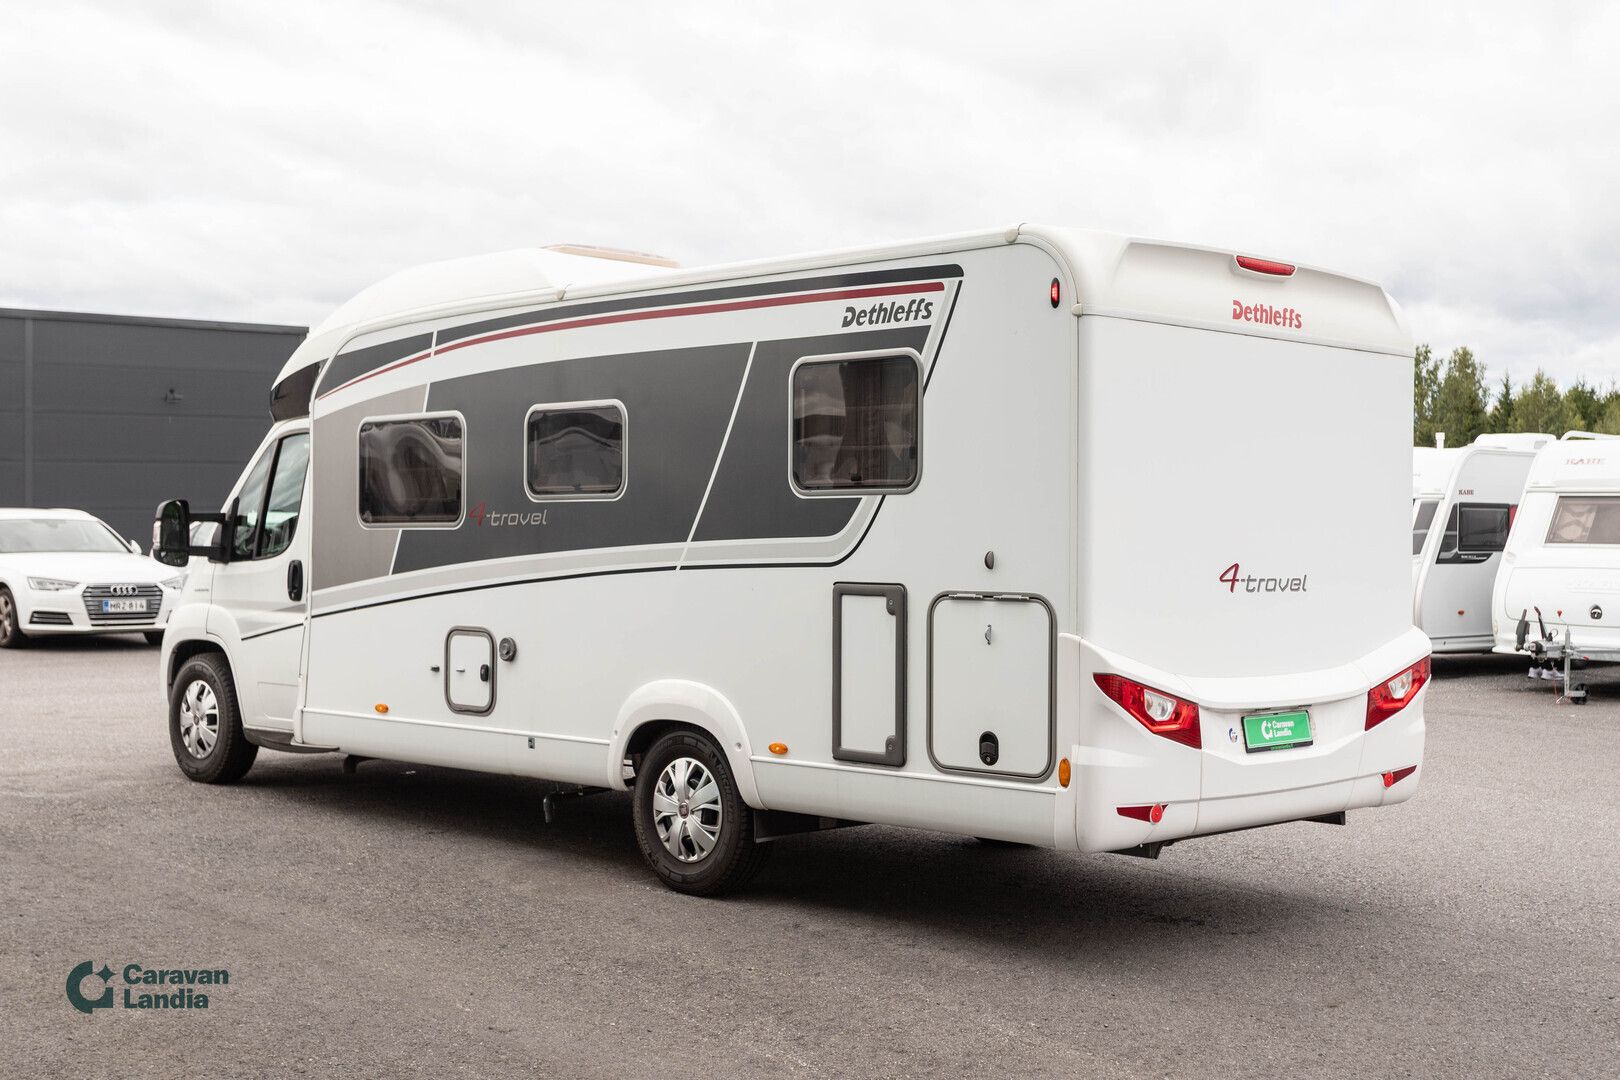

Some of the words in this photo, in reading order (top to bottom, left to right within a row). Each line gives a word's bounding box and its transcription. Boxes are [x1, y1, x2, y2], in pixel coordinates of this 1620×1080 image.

[841, 298, 934, 328] Dethleffs
[1232, 299, 1303, 329] Dethleffs
[468, 501, 548, 527] 4-travel
[1219, 562, 1308, 593] 4-travel
